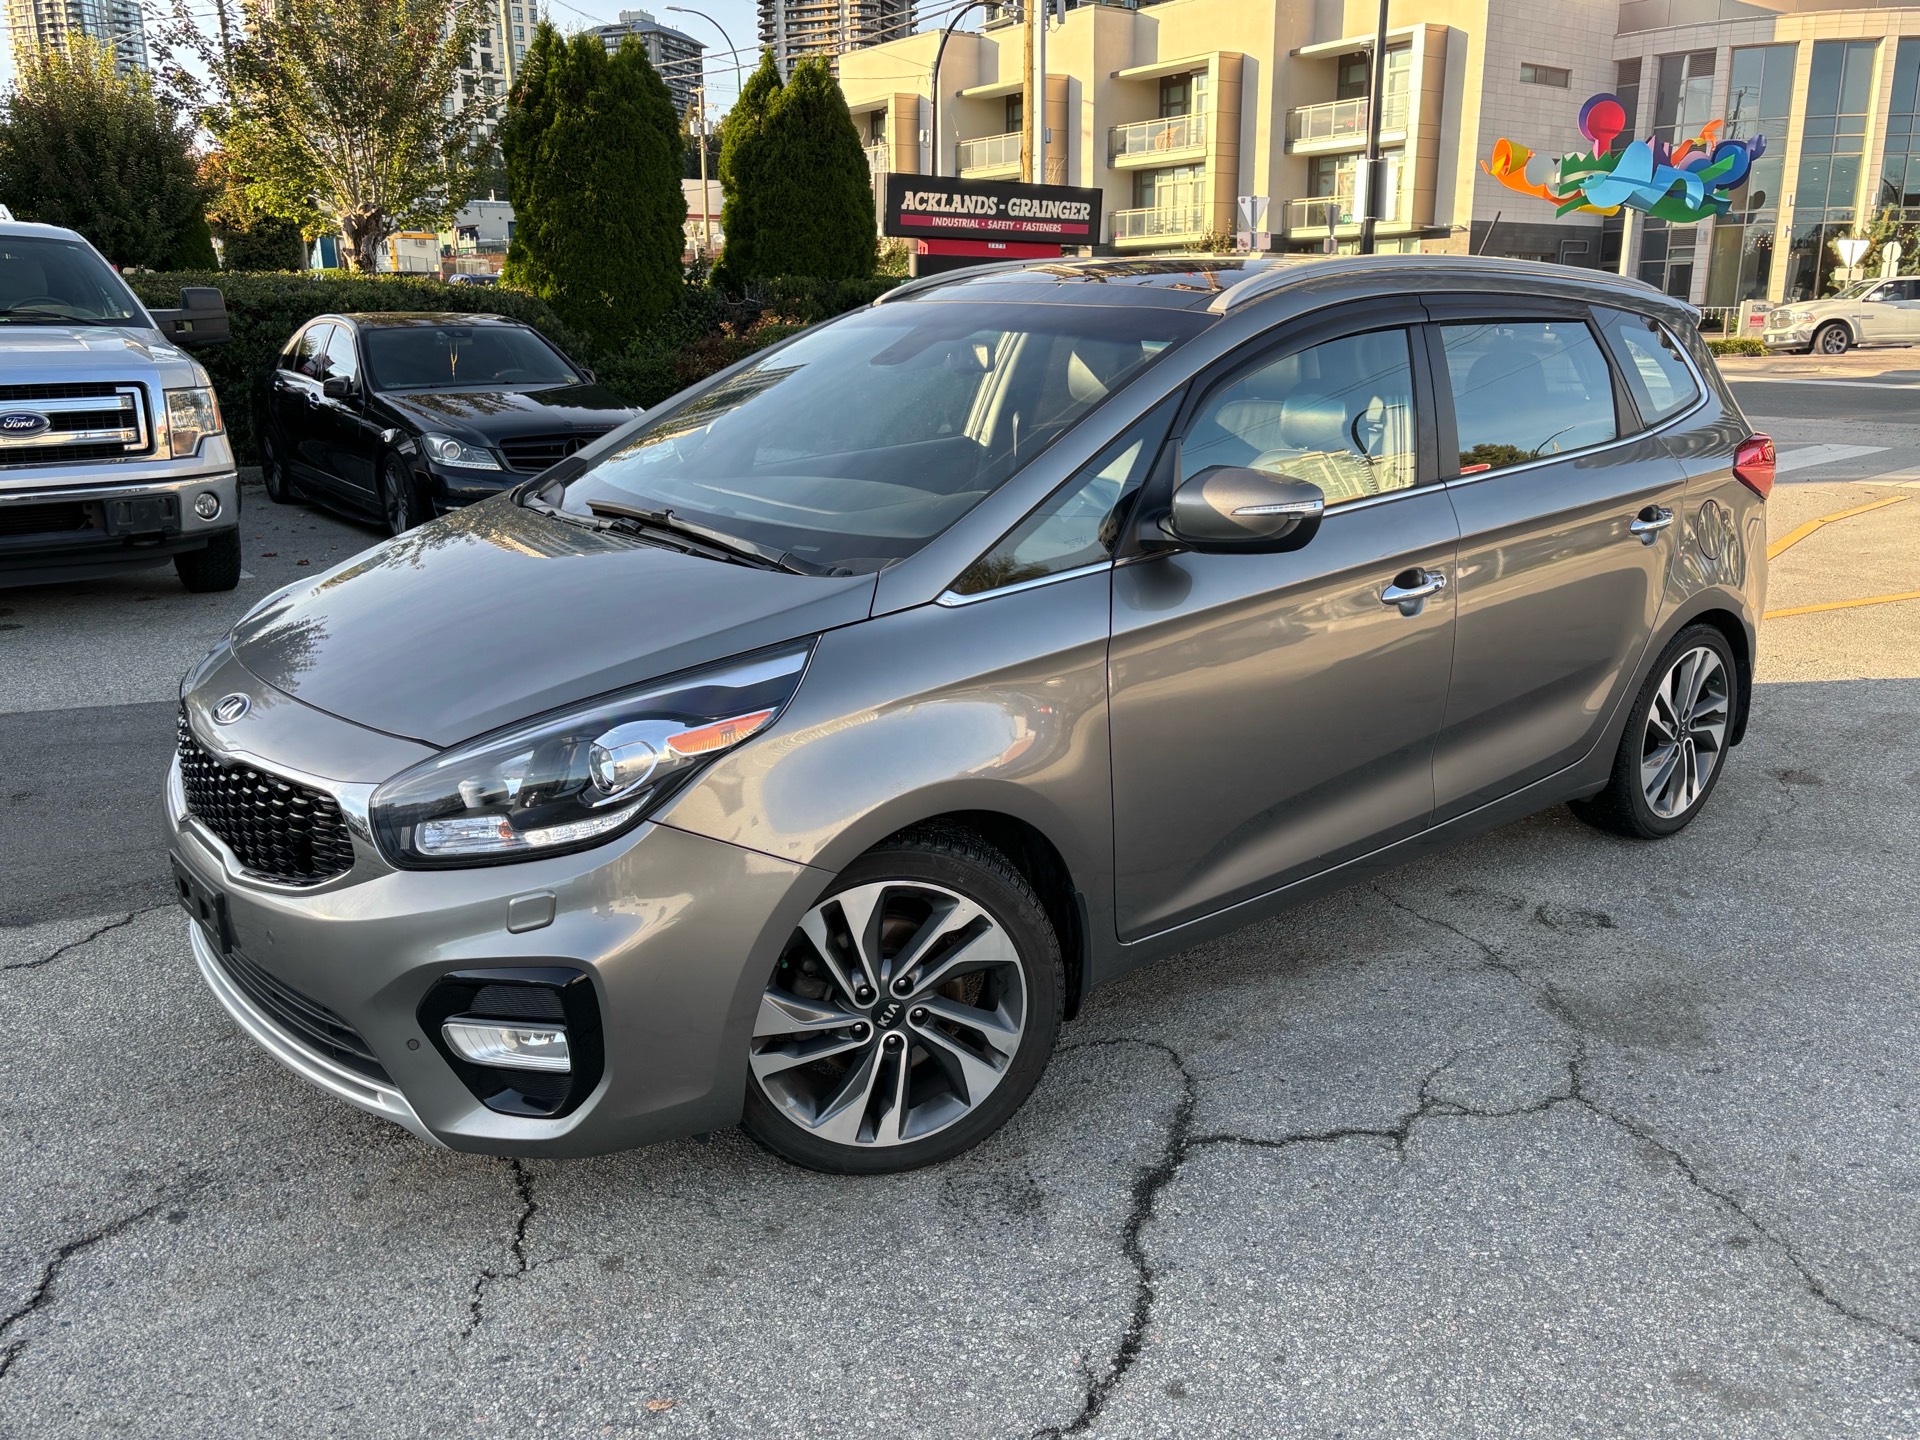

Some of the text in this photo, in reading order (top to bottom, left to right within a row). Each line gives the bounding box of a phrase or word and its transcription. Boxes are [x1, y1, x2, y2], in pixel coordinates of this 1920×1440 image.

[932, 216, 1062, 233] INDUSTRIAL SAFETY FASTENERS
[3, 416, 36, 429] Ford
[877, 1003, 900, 1027] KIA
